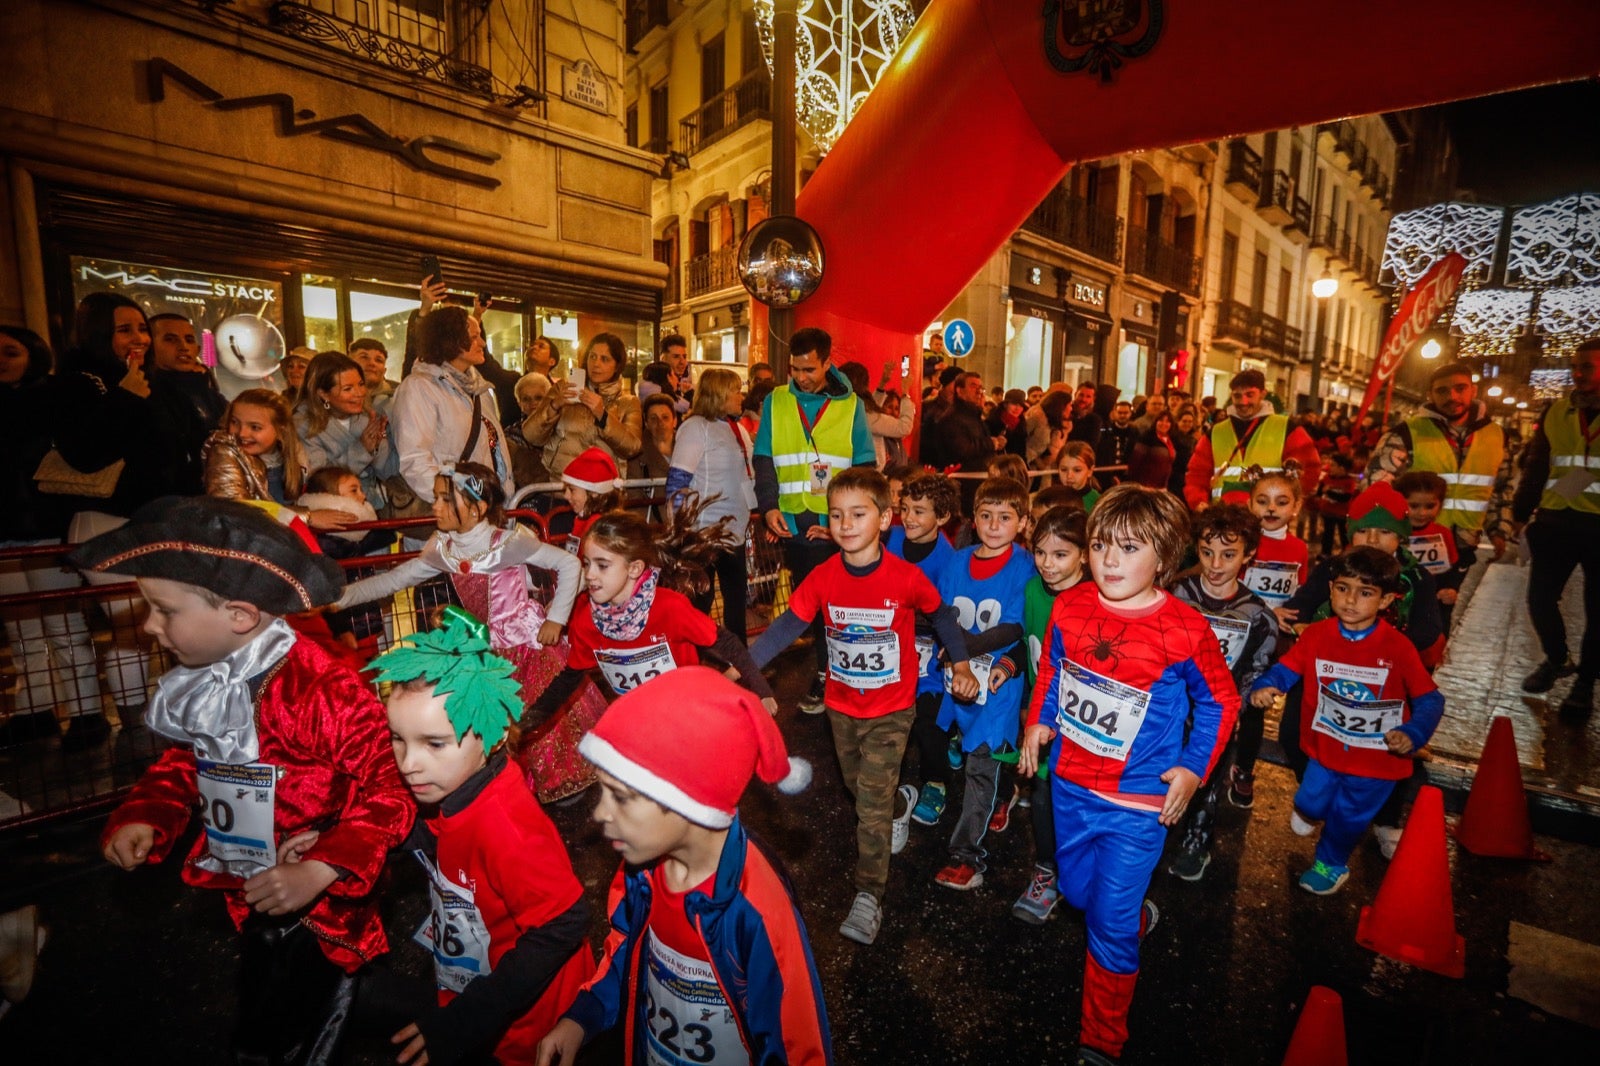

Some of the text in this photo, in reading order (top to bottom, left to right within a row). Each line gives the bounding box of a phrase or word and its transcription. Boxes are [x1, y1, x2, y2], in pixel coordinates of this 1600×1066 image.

[165, 294, 206, 305] MASCARA
[214, 282, 276, 302] STACK
[1258, 576, 1291, 594] 348
[835, 610, 846, 620] 30
[838, 651, 885, 671] 343
[1322, 663, 1334, 674] 30
[1064, 690, 1119, 736] 204
[1332, 709, 1383, 733] 321
[676, 961, 714, 979] NOCTURNA
